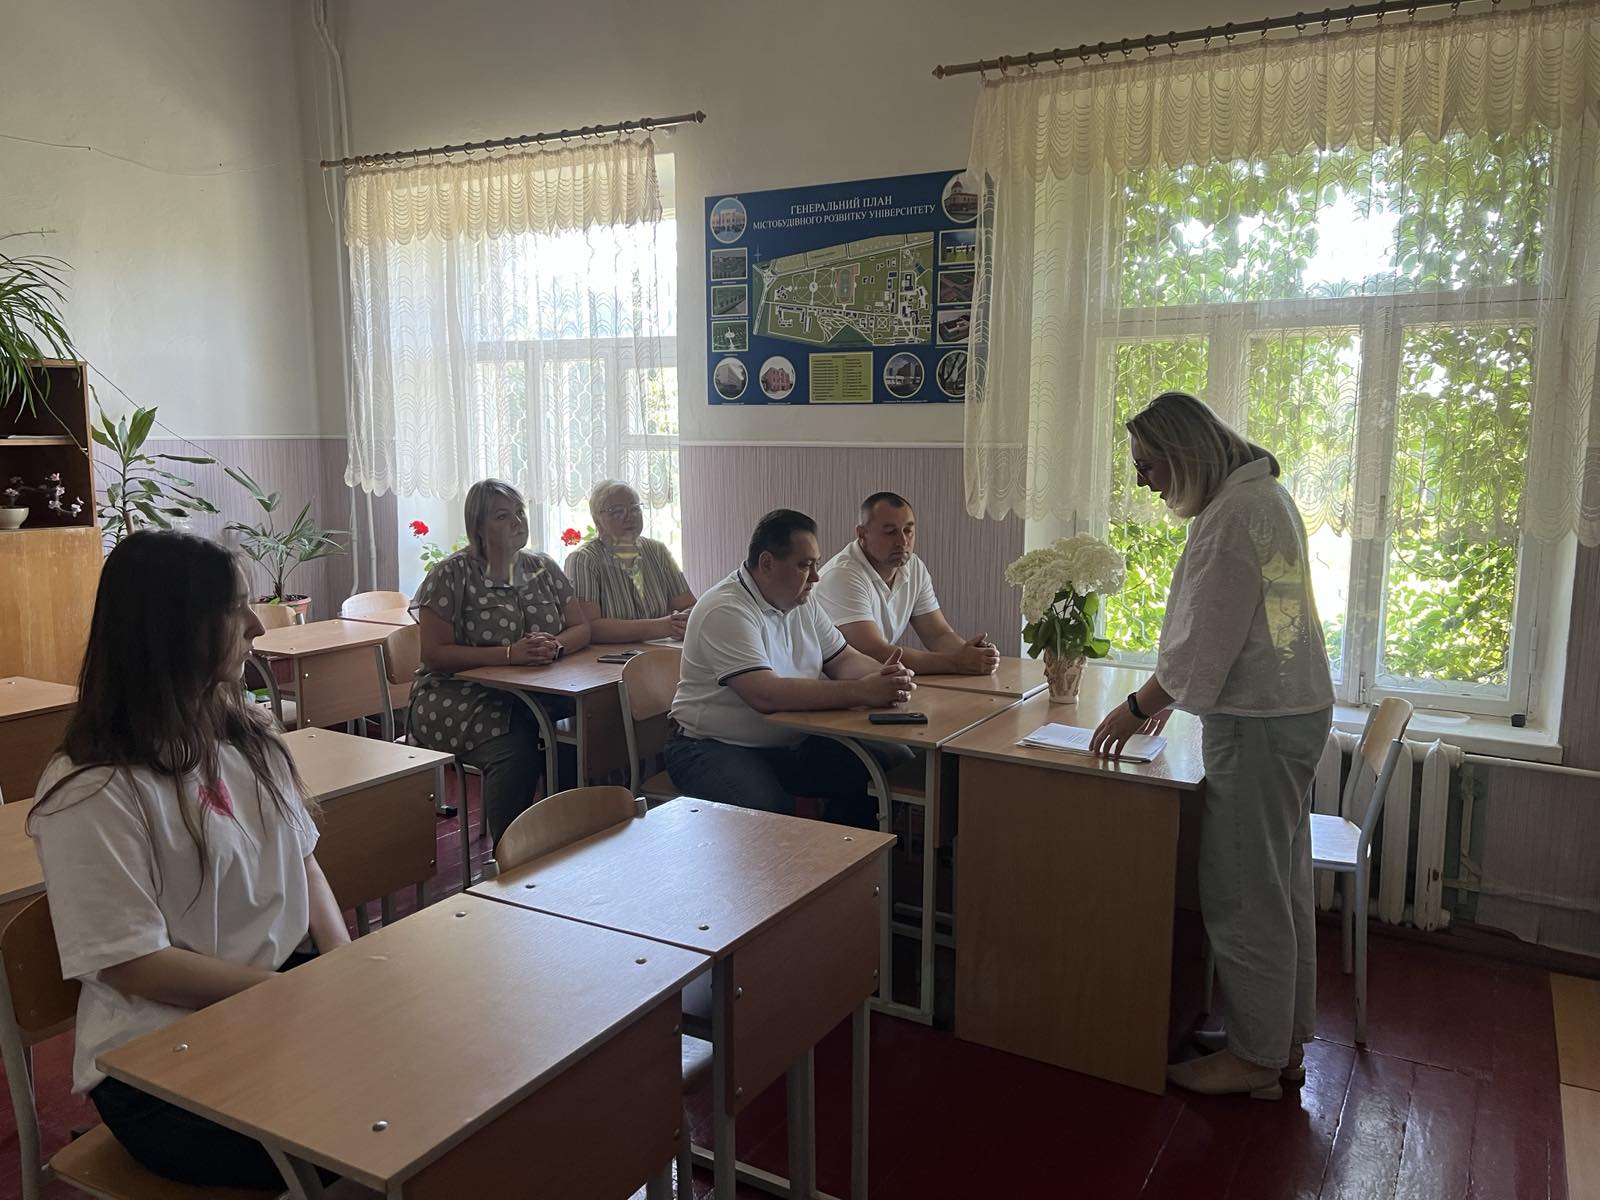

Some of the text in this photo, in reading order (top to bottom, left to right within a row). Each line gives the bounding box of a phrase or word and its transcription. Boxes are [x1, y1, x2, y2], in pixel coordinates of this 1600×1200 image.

[790, 195, 892, 215] ГЕНЕРАЛЬНИЙ ПЛАН
[753, 204, 936, 230] МІСТОБУДІВНОГО РОЗВИТКУ УНІВЕРСИТЕТУ
